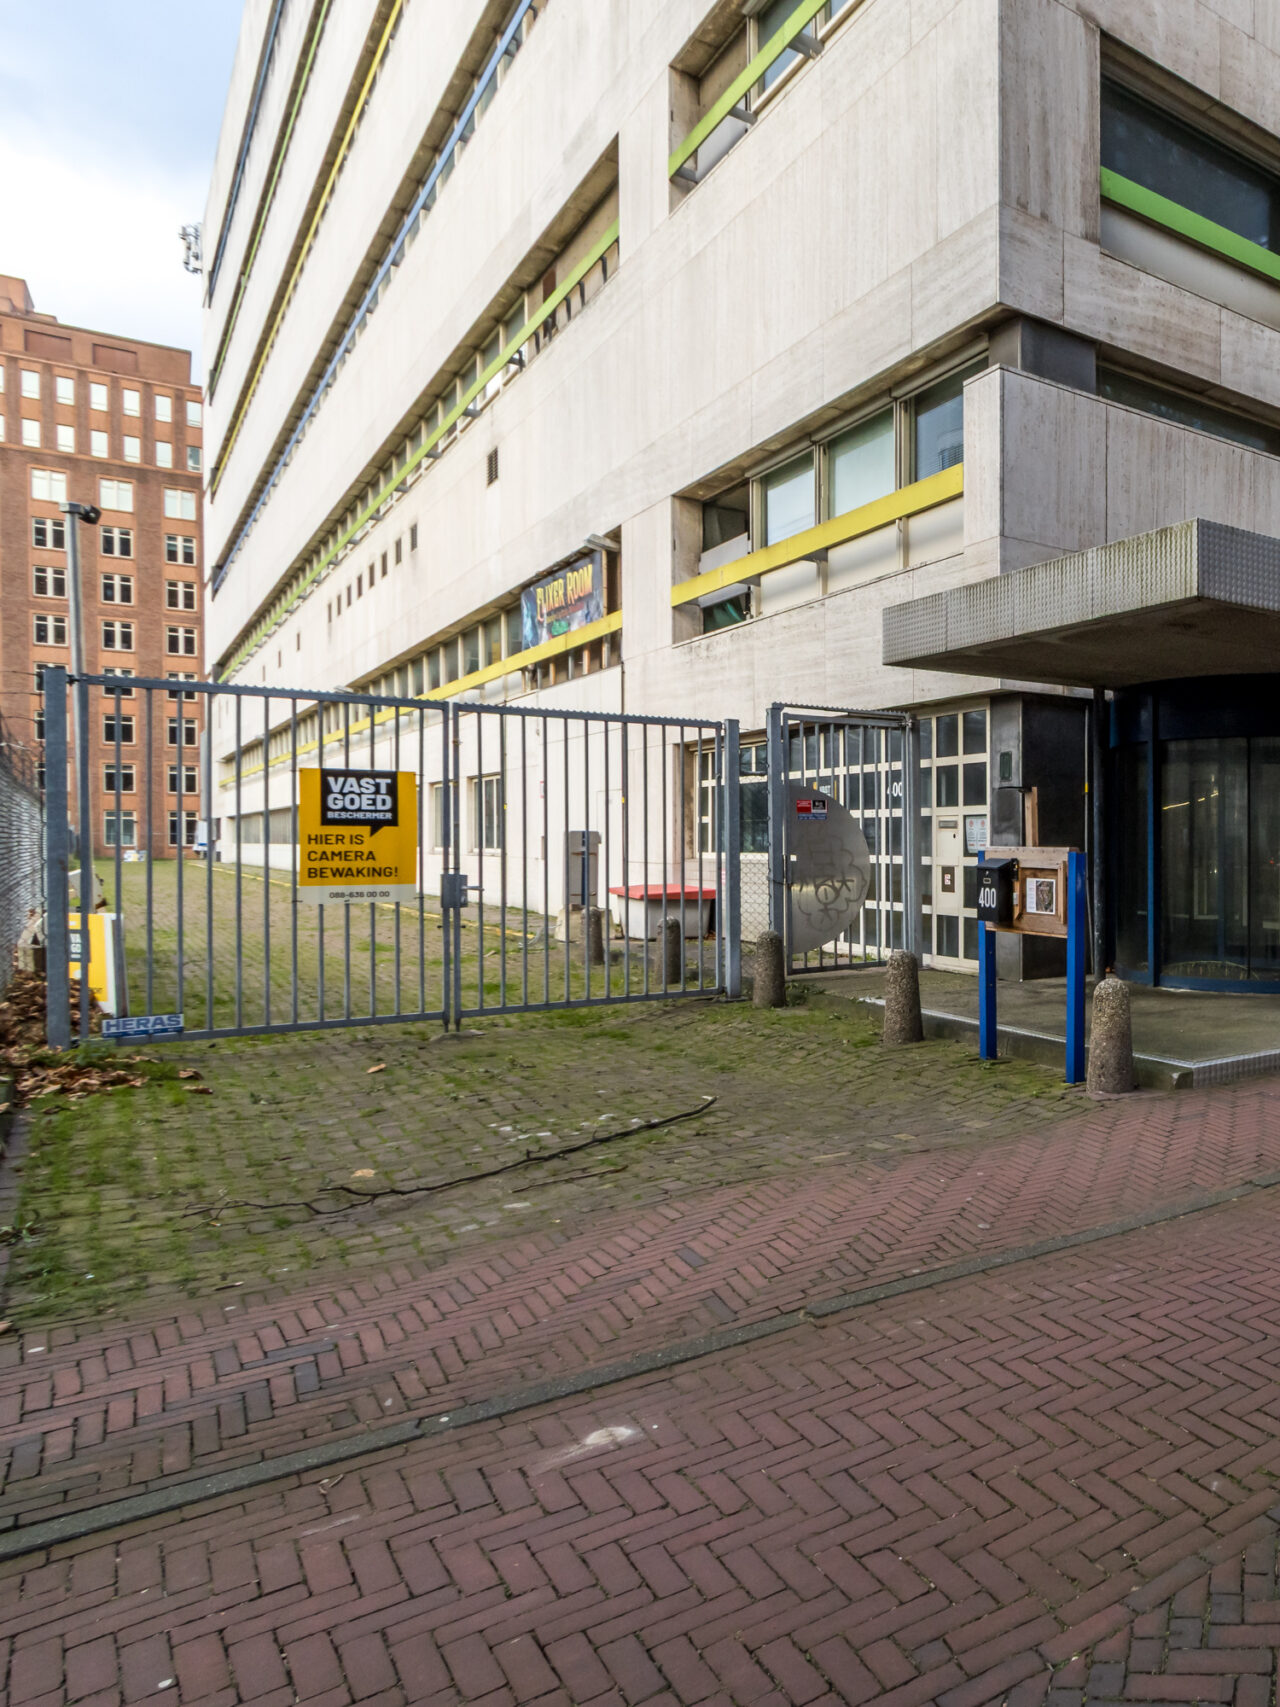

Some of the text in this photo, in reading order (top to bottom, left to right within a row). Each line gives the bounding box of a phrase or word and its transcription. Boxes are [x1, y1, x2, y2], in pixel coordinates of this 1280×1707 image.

[566, 564, 593, 605] ROOM
[327, 776, 392, 794] VAST
[327, 793, 392, 811] GOED
[326, 811, 392, 820] BESCHERMER
[307, 833, 365, 845] HIER IS
[307, 850, 377, 862] CAMERA
[307, 866, 398, 879] BEWAKING!
[379, 890, 390, 898] 00
[978, 887, 997, 908] 400
[105, 1015, 181, 1032] HERAS
